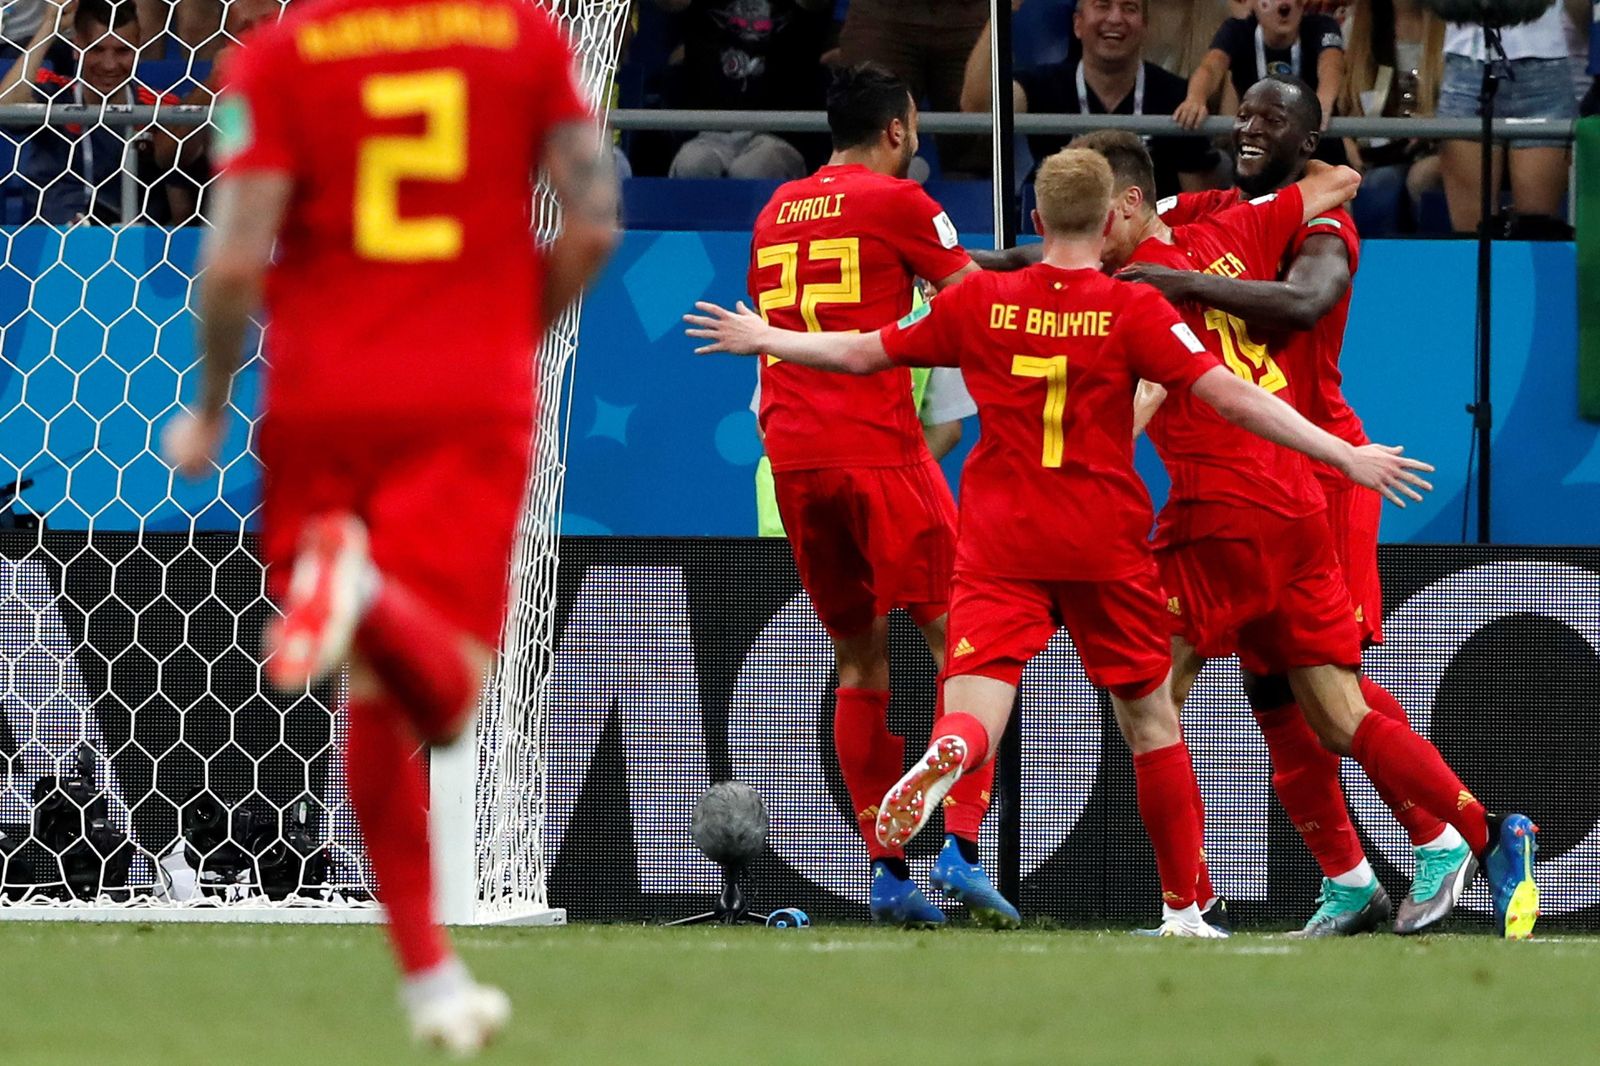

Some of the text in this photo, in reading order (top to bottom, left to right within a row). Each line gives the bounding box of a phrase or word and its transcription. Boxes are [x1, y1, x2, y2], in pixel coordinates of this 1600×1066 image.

[353, 67, 467, 263] 2
[776, 193, 845, 225] CHADLI
[756, 237, 861, 368] 22
[989, 303, 1112, 337] DE BRUYNE
[1011, 354, 1067, 468] 7
